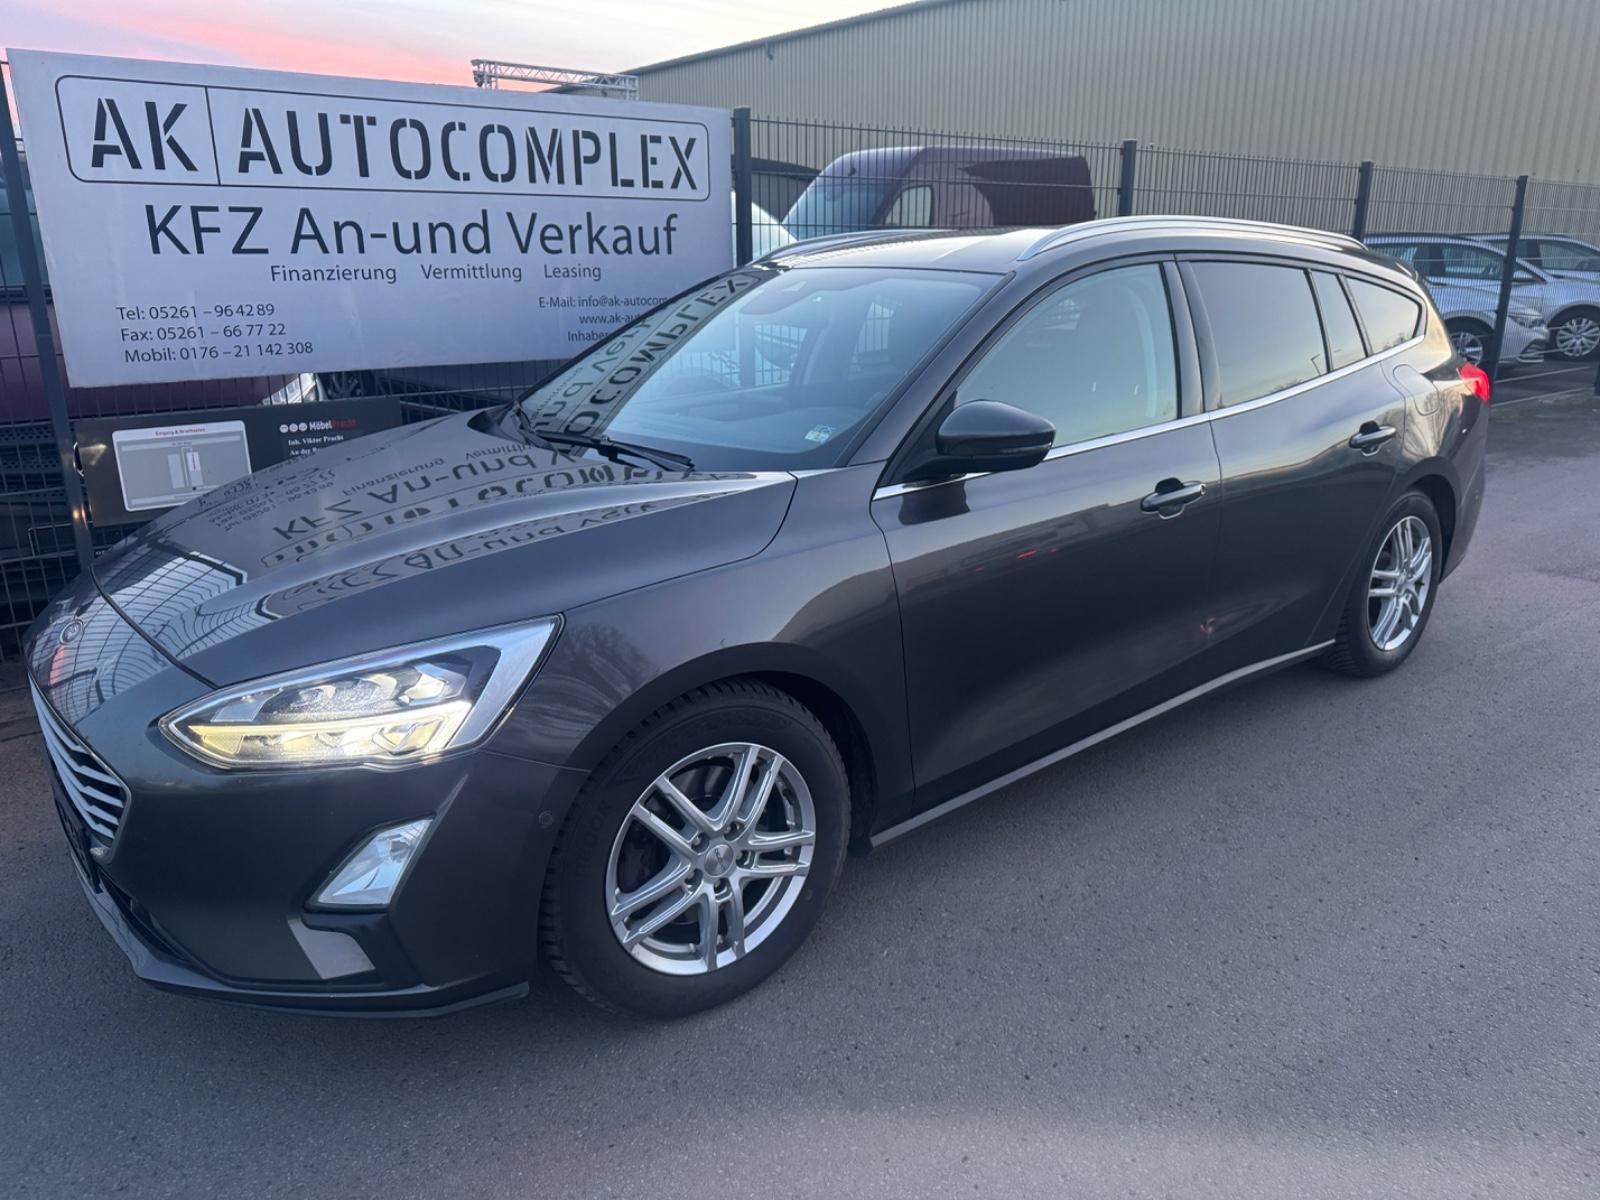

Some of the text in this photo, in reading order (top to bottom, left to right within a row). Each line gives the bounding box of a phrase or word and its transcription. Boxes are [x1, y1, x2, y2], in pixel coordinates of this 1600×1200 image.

[91, 97, 698, 191] AK AUTOCOMPLEX
[144, 204, 678, 256] KFZ An-und Verkauf
[270, 263, 602, 284] Finanzierung Vermittlung Leasing
[538, 296, 576, 309] E-Mail:
[115, 306, 146, 321] Tel:
[149, 305, 197, 320] 05261
[121, 328, 153, 342] Fax:
[157, 326, 204, 341] 05261
[124, 347, 176, 363] Mobil:
[179, 346, 219, 361] 0176
